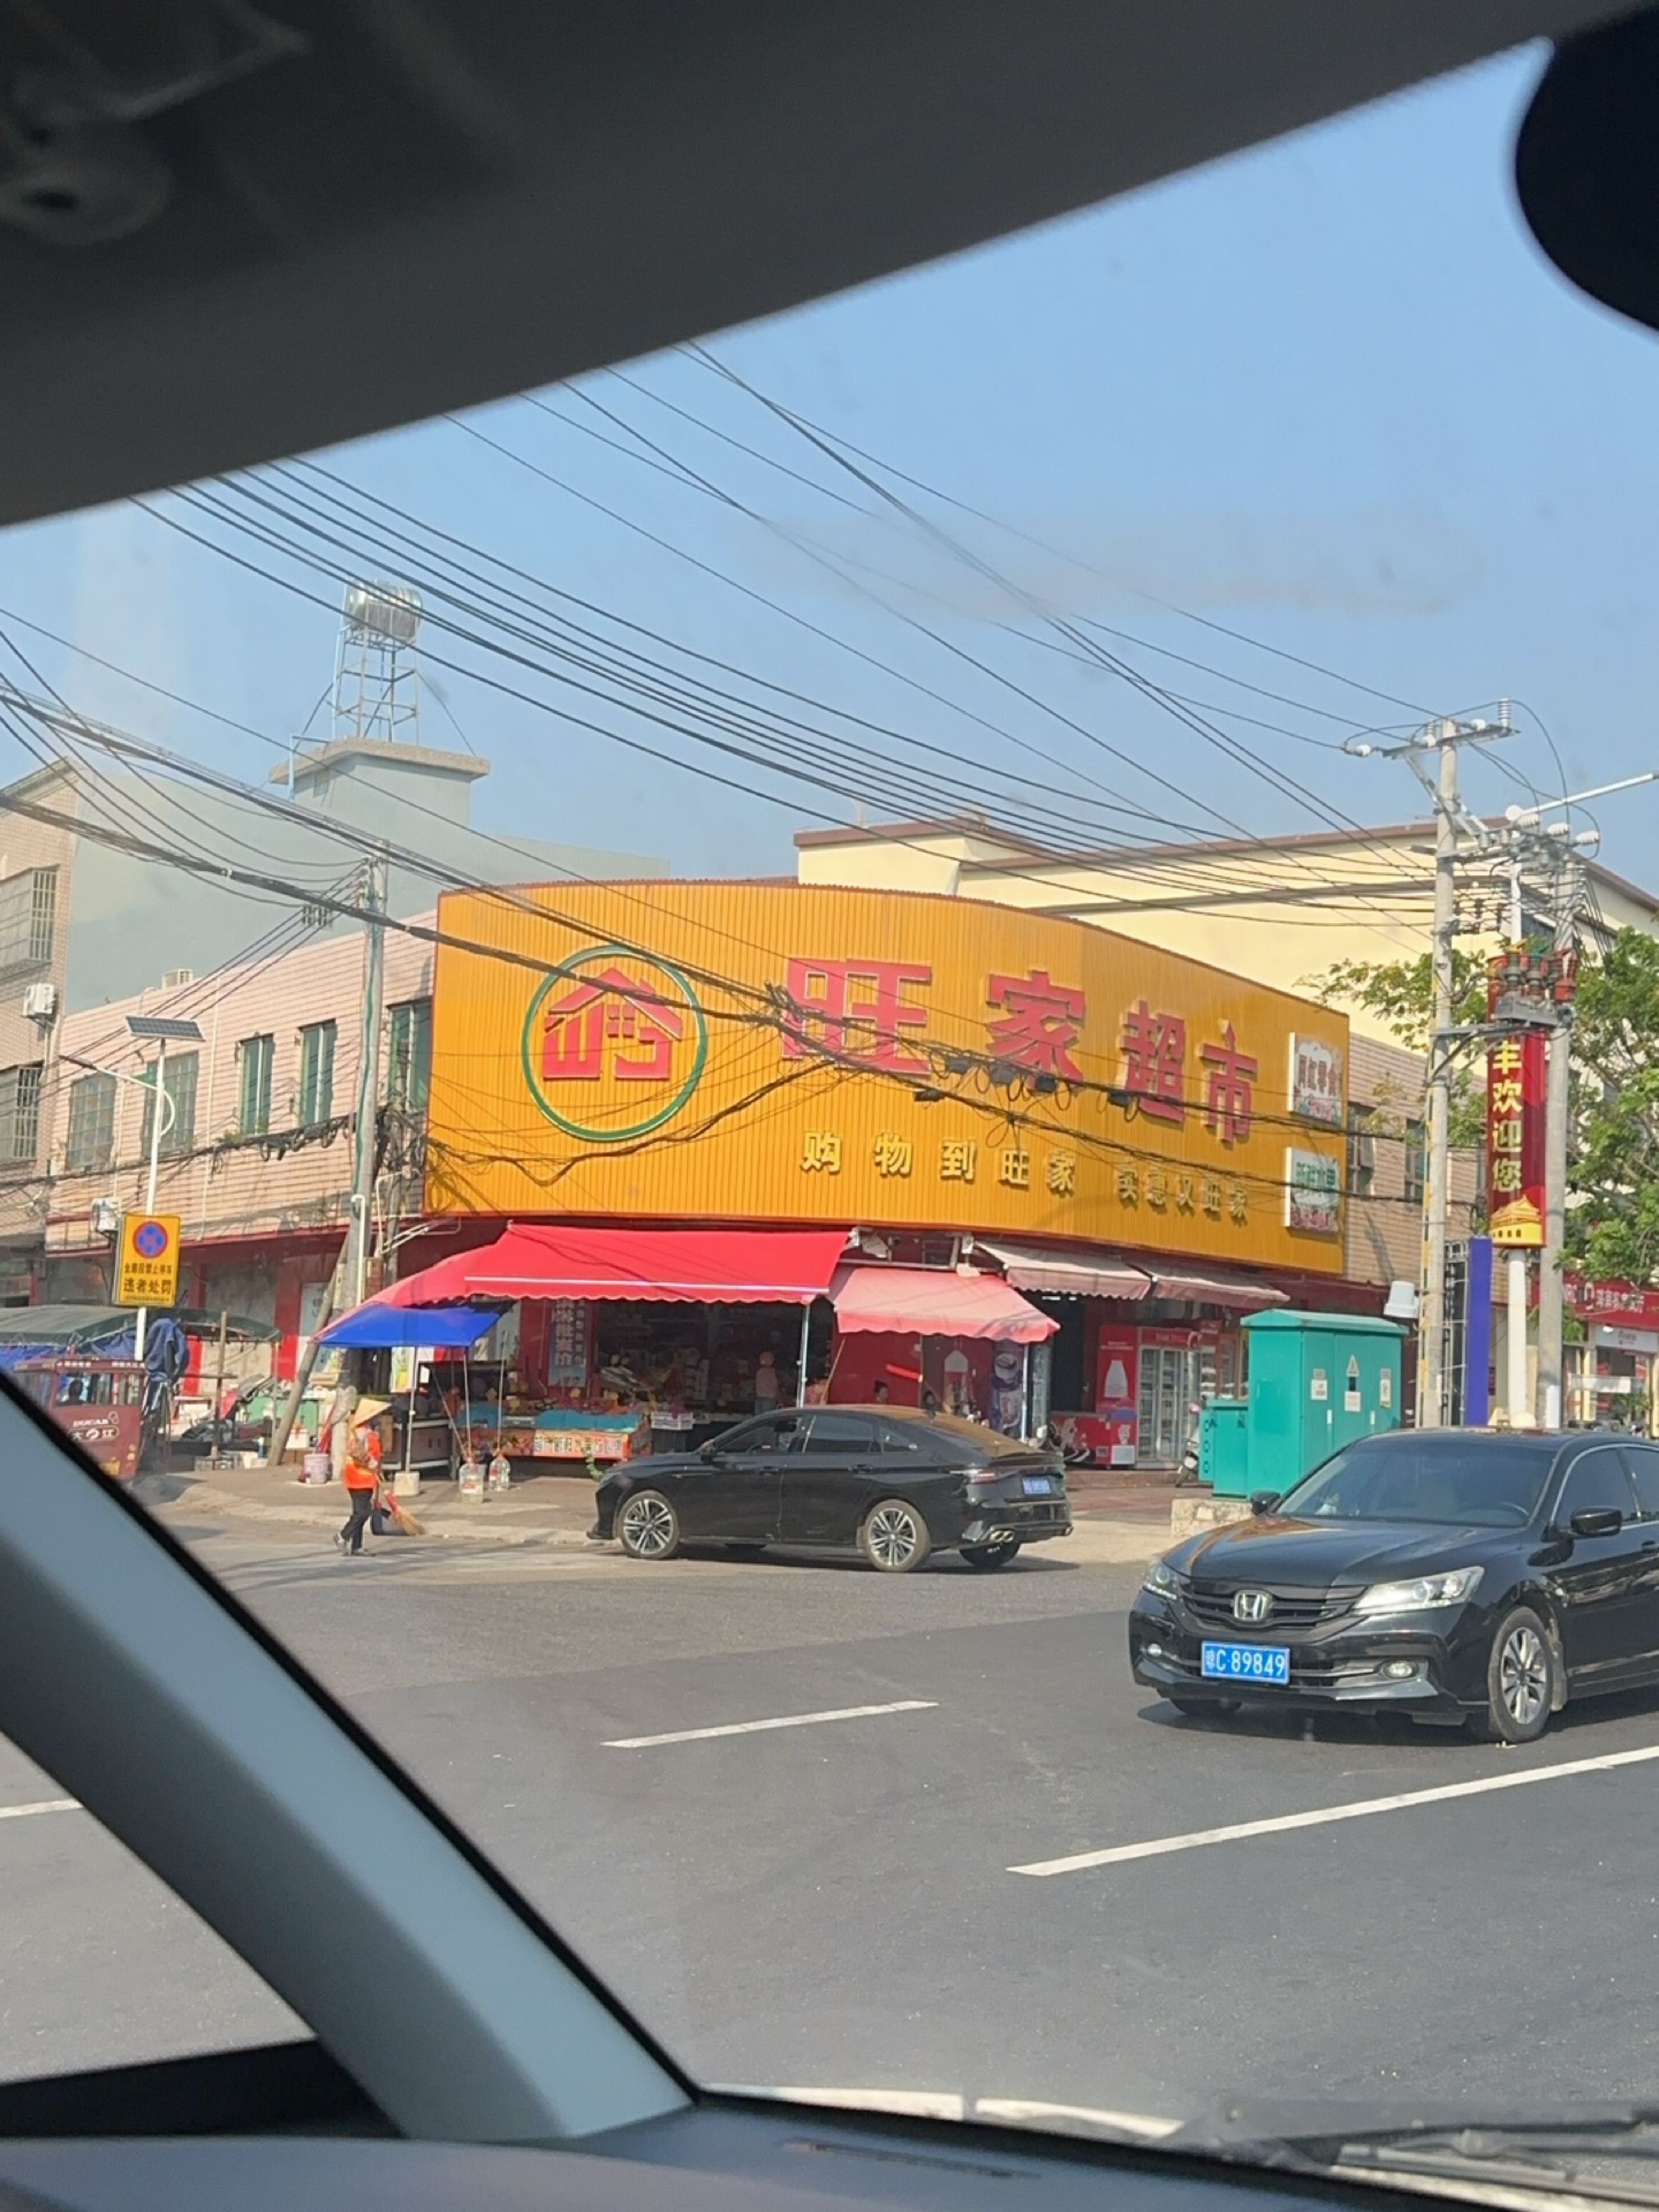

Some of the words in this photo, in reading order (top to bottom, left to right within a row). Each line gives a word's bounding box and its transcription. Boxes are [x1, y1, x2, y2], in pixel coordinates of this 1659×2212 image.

[782, 957, 1258, 1143] 旺家超市
[800, 1130, 1076, 1193] 购物到旺家
[124, 1277, 172, 1295] 违者处罚
